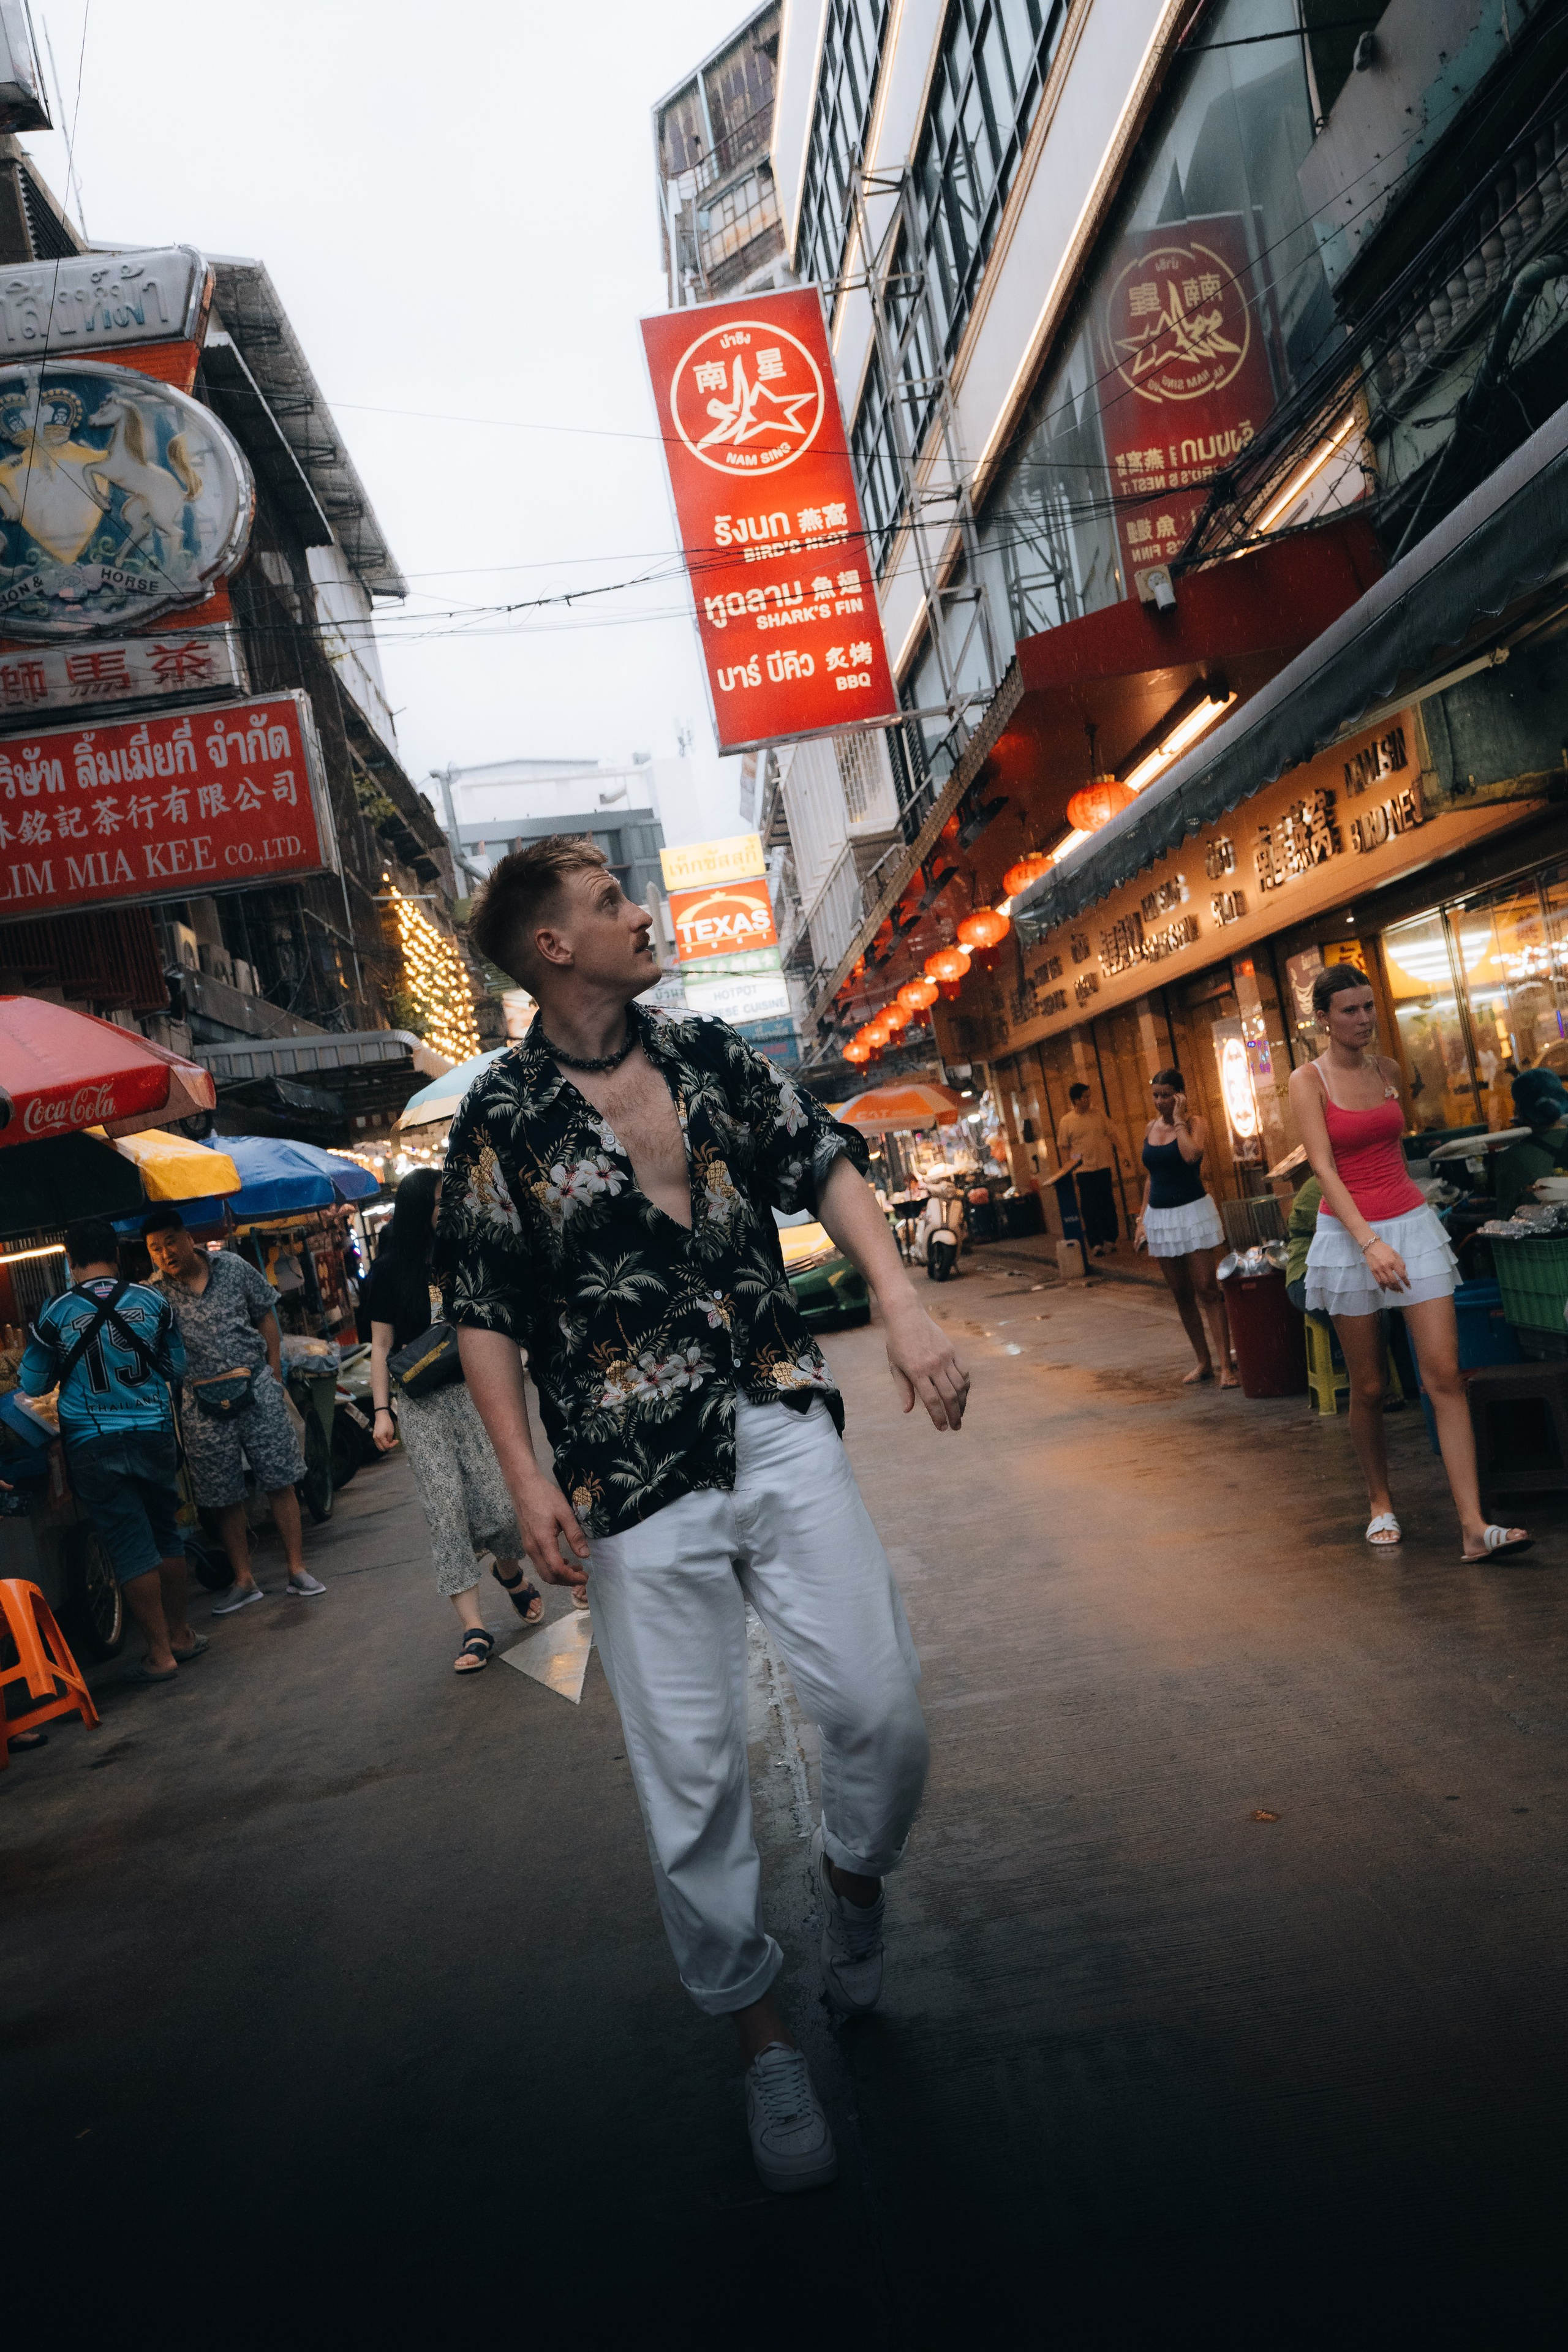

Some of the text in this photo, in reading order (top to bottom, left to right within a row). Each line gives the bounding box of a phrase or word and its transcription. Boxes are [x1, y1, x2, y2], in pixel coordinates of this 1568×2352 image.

[693, 347, 787, 394] 南 星
[726, 442, 791, 466] NAM SING
[714, 514, 791, 546] รังนก
[744, 539, 802, 563] BIRD'S
[32, 576, 44, 589] &
[101, 568, 159, 592] HORSE
[704, 581, 804, 629] หูฉลาม
[756, 597, 864, 630] SHARK'S FIN
[717, 654, 762, 692] บาร์
[766, 649, 815, 682] บีคิว
[835, 672, 872, 691] BBQ
[206, 713, 292, 769] จำกัด
[64, 848, 137, 891] MIA
[143, 835, 217, 878] KEE
[224, 835, 306, 866] CO.,LTD.
[676, 909, 771, 943] TEXAS
[714, 984, 758, 1001] HOTPOT
[743, 997, 786, 1014] CUISINE
[89, 1393, 160, 1413] THAILAND
